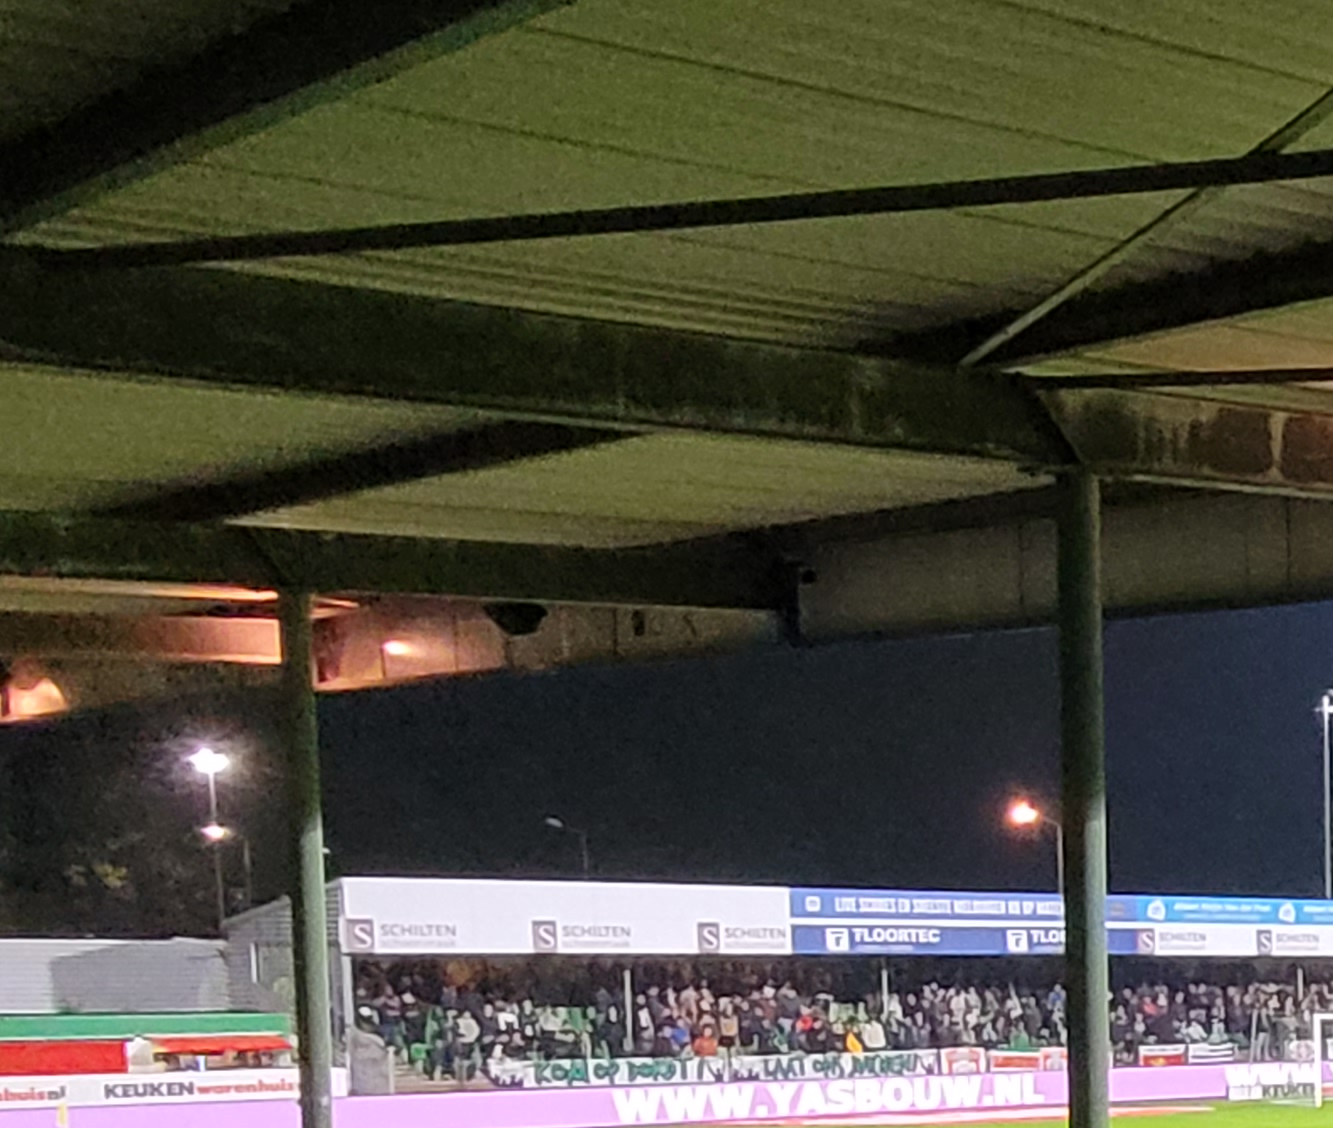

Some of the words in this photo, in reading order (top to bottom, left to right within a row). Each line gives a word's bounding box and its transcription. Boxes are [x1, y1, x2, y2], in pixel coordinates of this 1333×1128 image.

[380, 923, 457, 937] SCHILTEN
[562, 925, 632, 938] SCHILTEN
[724, 926, 787, 939] SCHILTEN
[611, 1072, 1045, 1124] WWW.YASBOUW.NL
